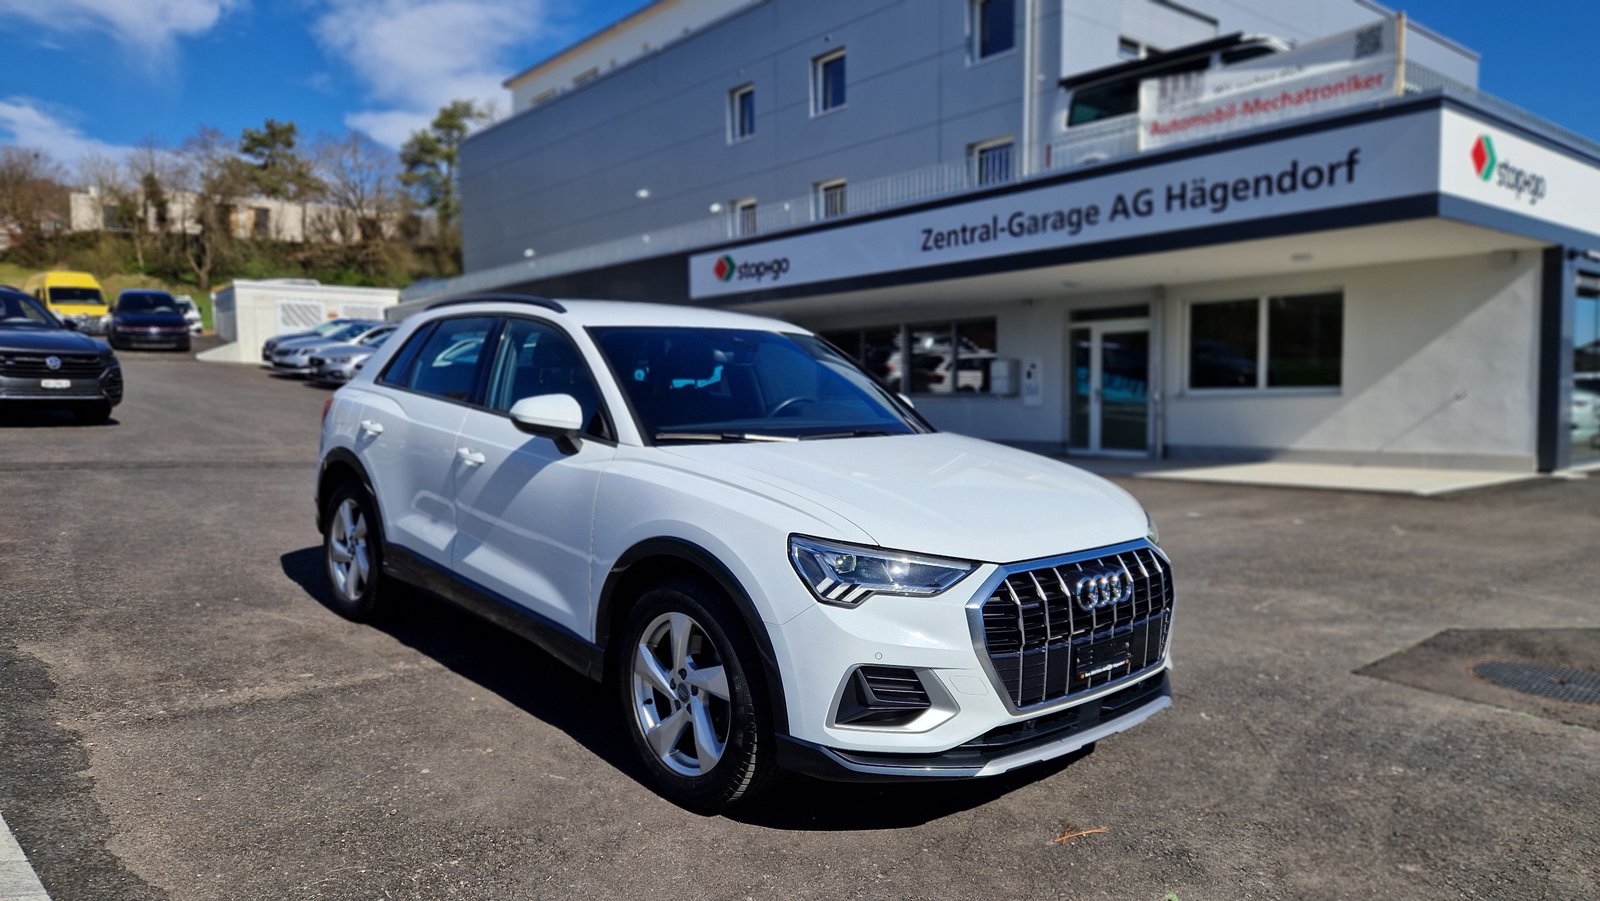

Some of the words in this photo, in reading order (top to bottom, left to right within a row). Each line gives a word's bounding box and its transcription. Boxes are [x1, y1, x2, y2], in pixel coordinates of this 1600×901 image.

[1150, 71, 1385, 136] Automobil-Mechatroniker
[921, 201, 1100, 252] Zentral-Garage
[1108, 188, 1155, 222] AG
[1165, 147, 1361, 212] Hägendorf
